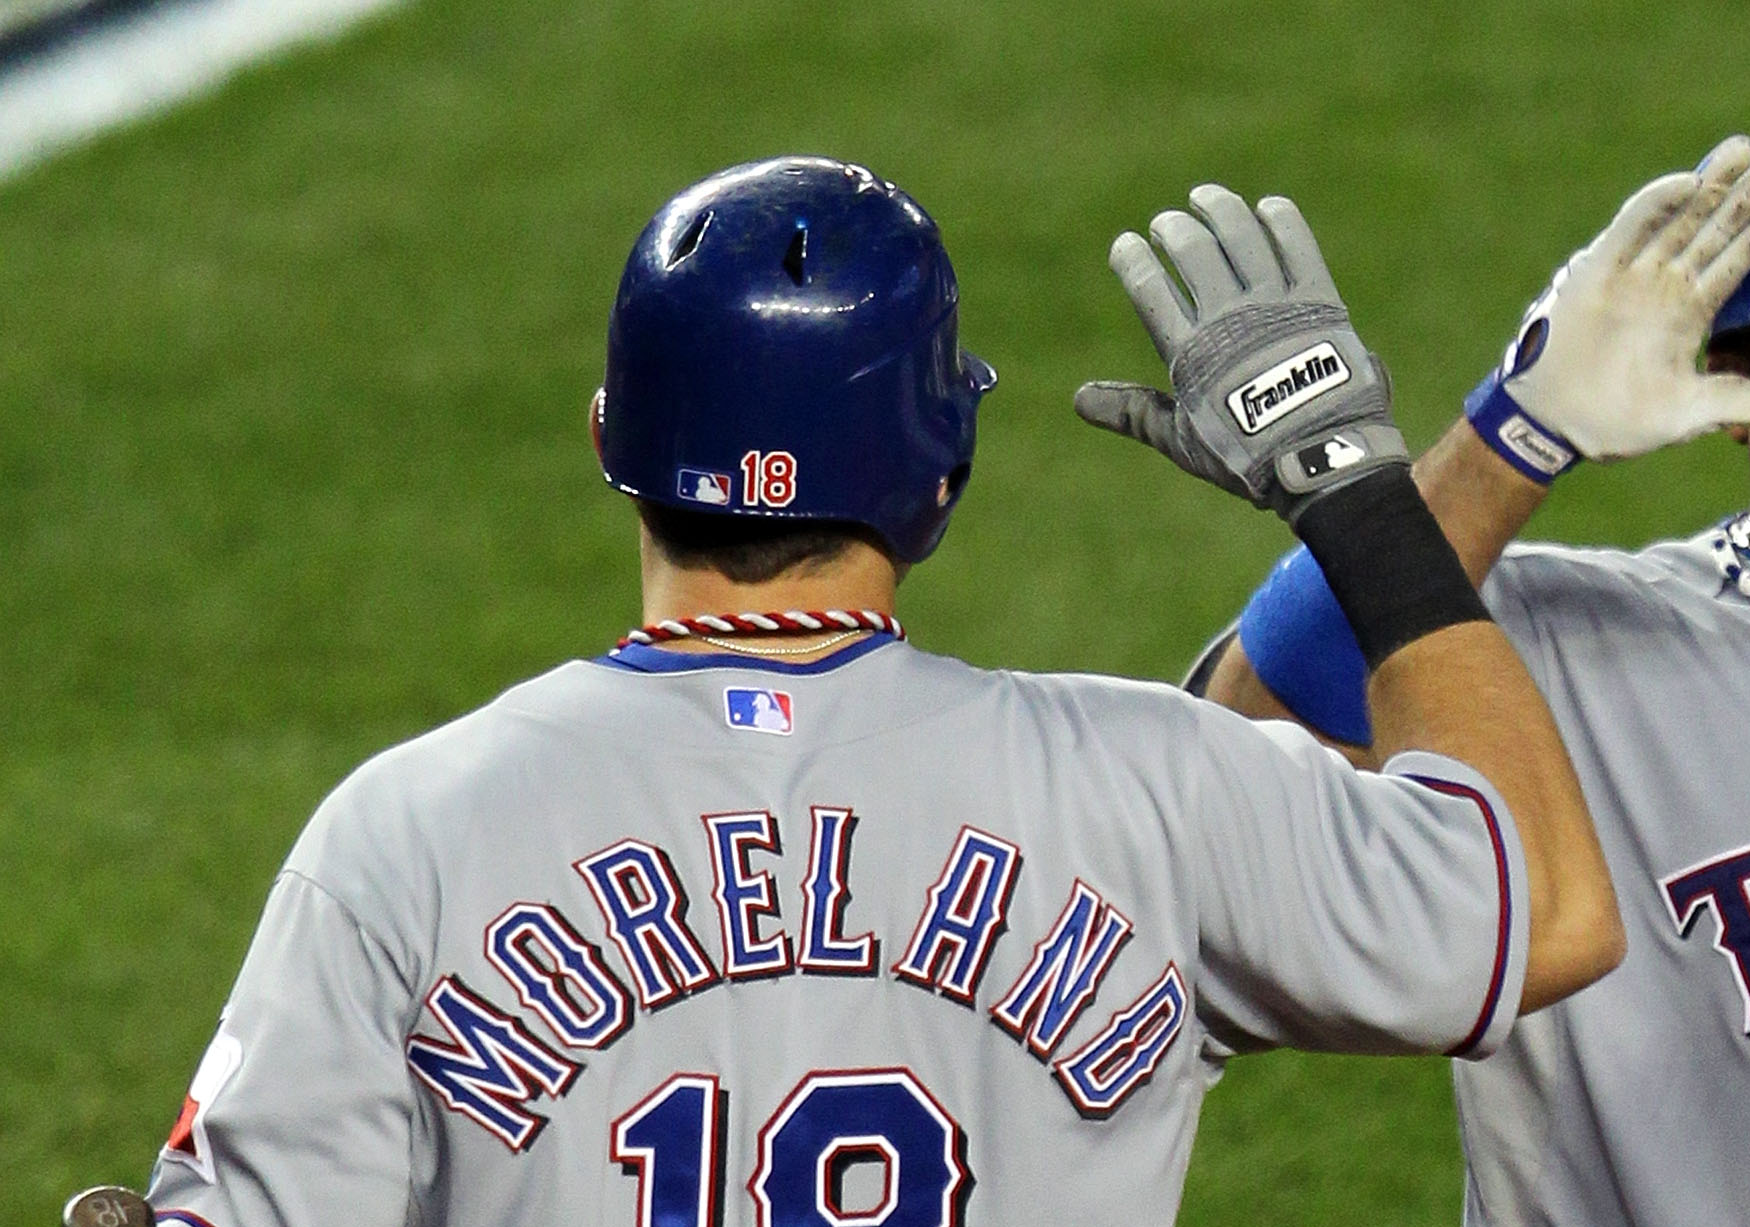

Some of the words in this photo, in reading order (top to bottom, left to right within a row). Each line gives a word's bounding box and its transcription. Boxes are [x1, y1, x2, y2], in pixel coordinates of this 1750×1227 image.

[1240, 355, 1340, 430] Franklin
[740, 450, 797, 507] 18
[406, 806, 1190, 1154] MORELAND
